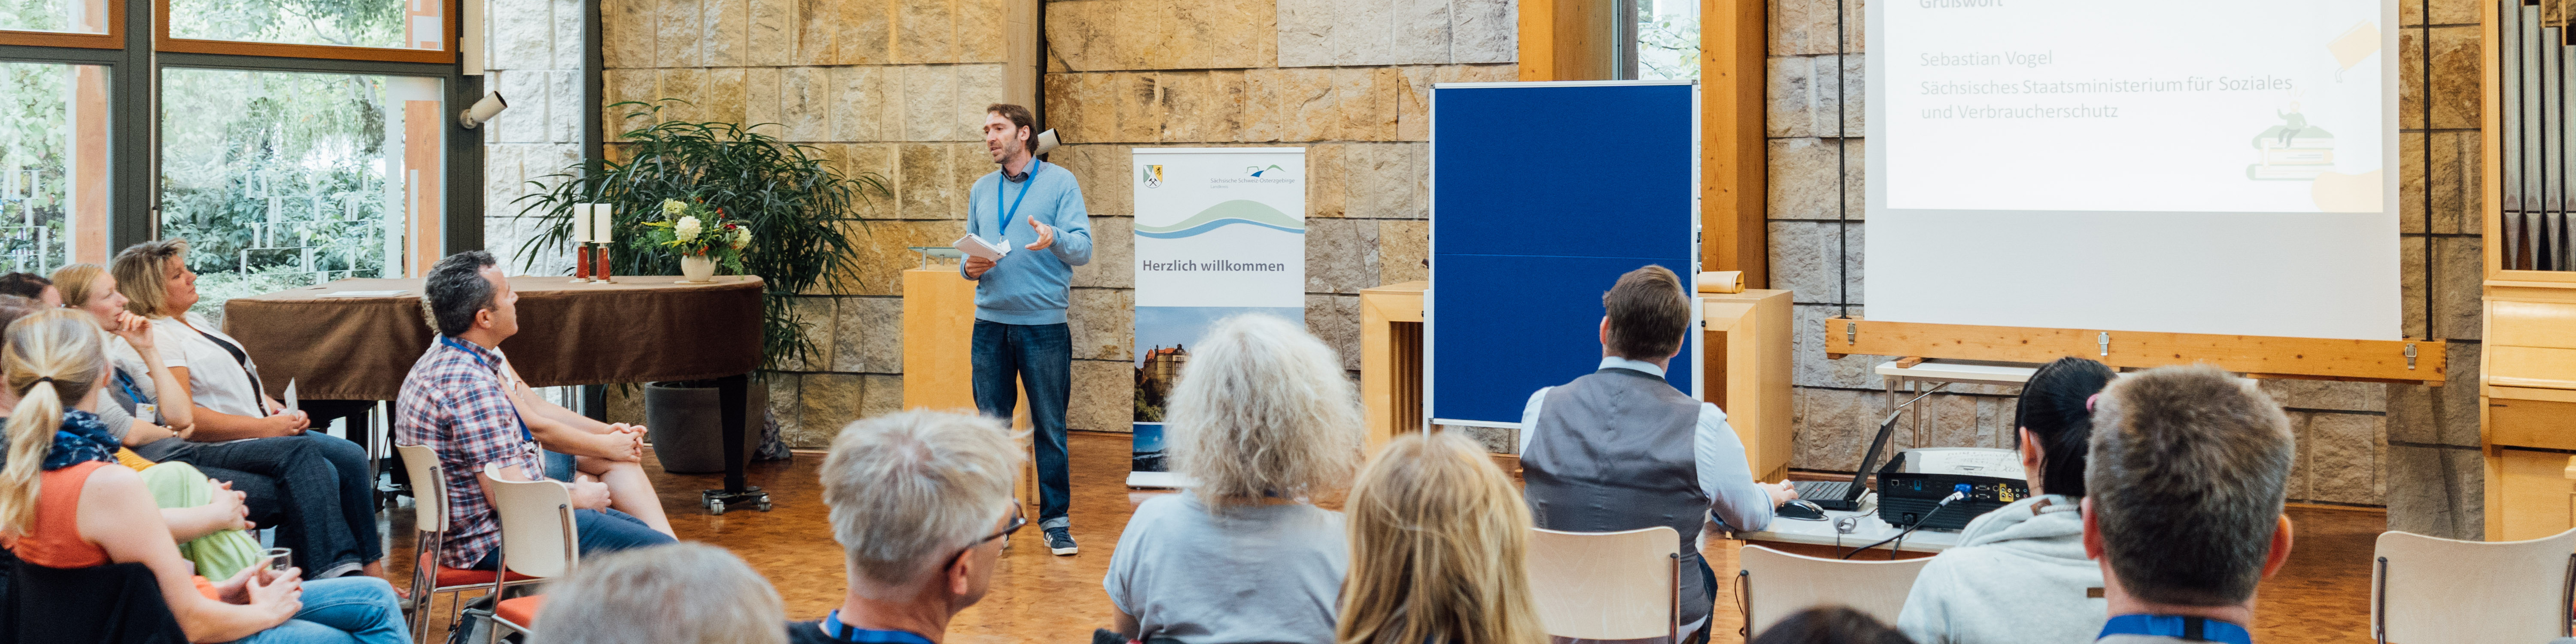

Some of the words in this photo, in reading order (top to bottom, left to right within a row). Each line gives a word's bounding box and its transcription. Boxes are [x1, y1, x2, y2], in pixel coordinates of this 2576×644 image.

[1920, 51, 2000, 67] Sebastian
[2005, 49, 2052, 68] Vogel
[1921, 79, 2019, 95] Sächsisches
[2023, 77, 2182, 94] Staatsministerium
[2187, 76, 2214, 92] für
[2218, 74, 2293, 91] Soziales
[1922, 104, 1953, 119] und
[1957, 103, 2119, 119] Verbraucherschutz
[1143, 259, 1197, 272] Herzlich
[1201, 259, 1285, 272] willkommen
